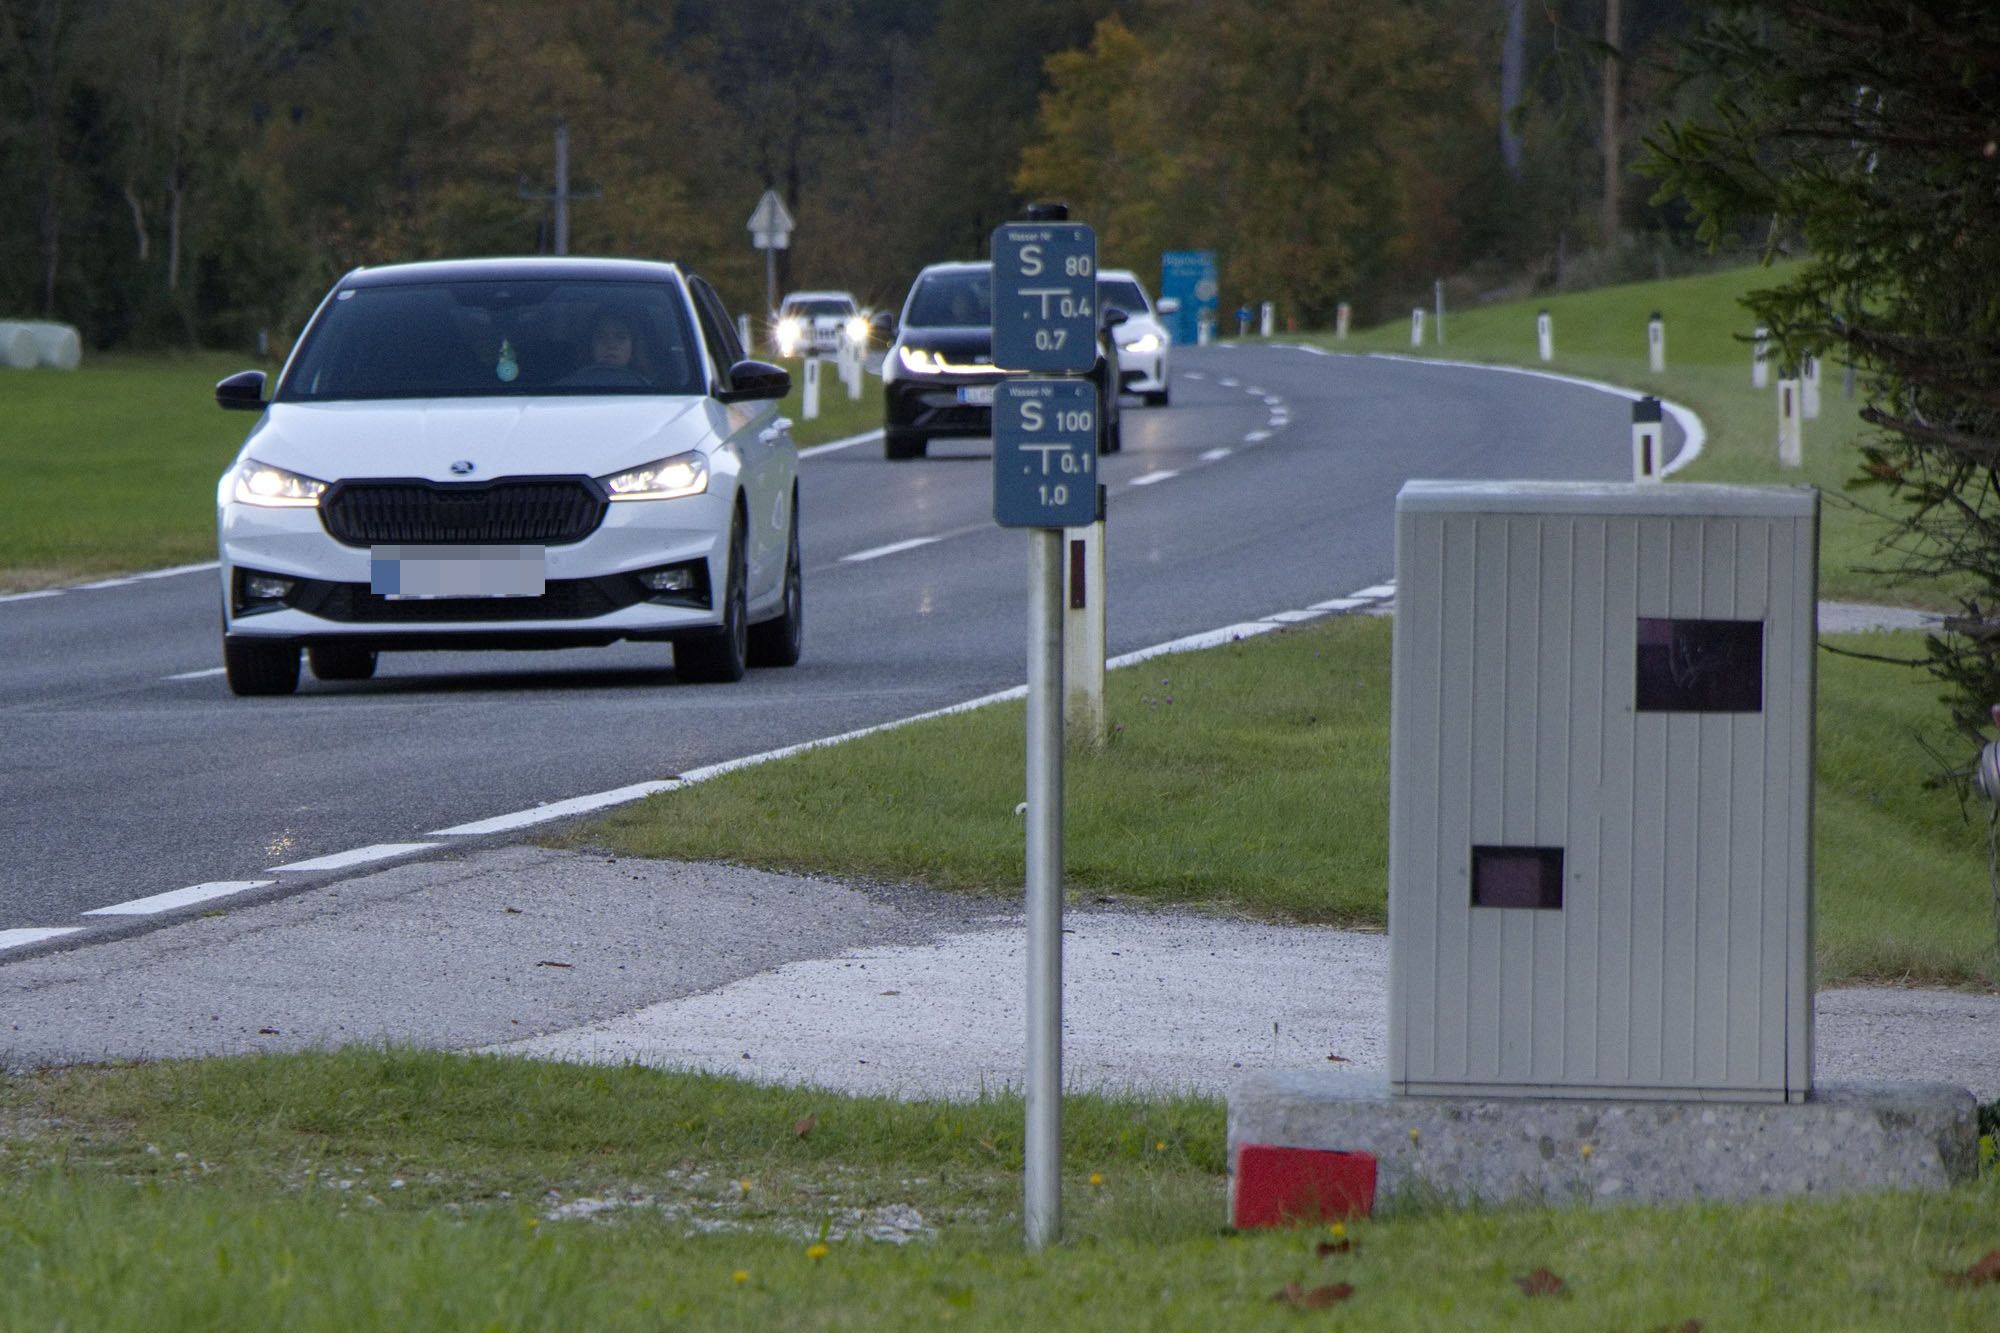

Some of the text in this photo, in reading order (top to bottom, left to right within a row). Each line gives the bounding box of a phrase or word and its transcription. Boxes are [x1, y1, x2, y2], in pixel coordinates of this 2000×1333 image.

[1008, 232, 1038, 241] Wasser
[1019, 244, 1091, 277] S 80
[1060, 298, 1091, 318] 0.4
[1035, 330, 1067, 350] 0.7
[1020, 399, 1091, 431] S 100
[1061, 453, 1090, 473] 0.1
[1038, 485, 1068, 505] 1.0
